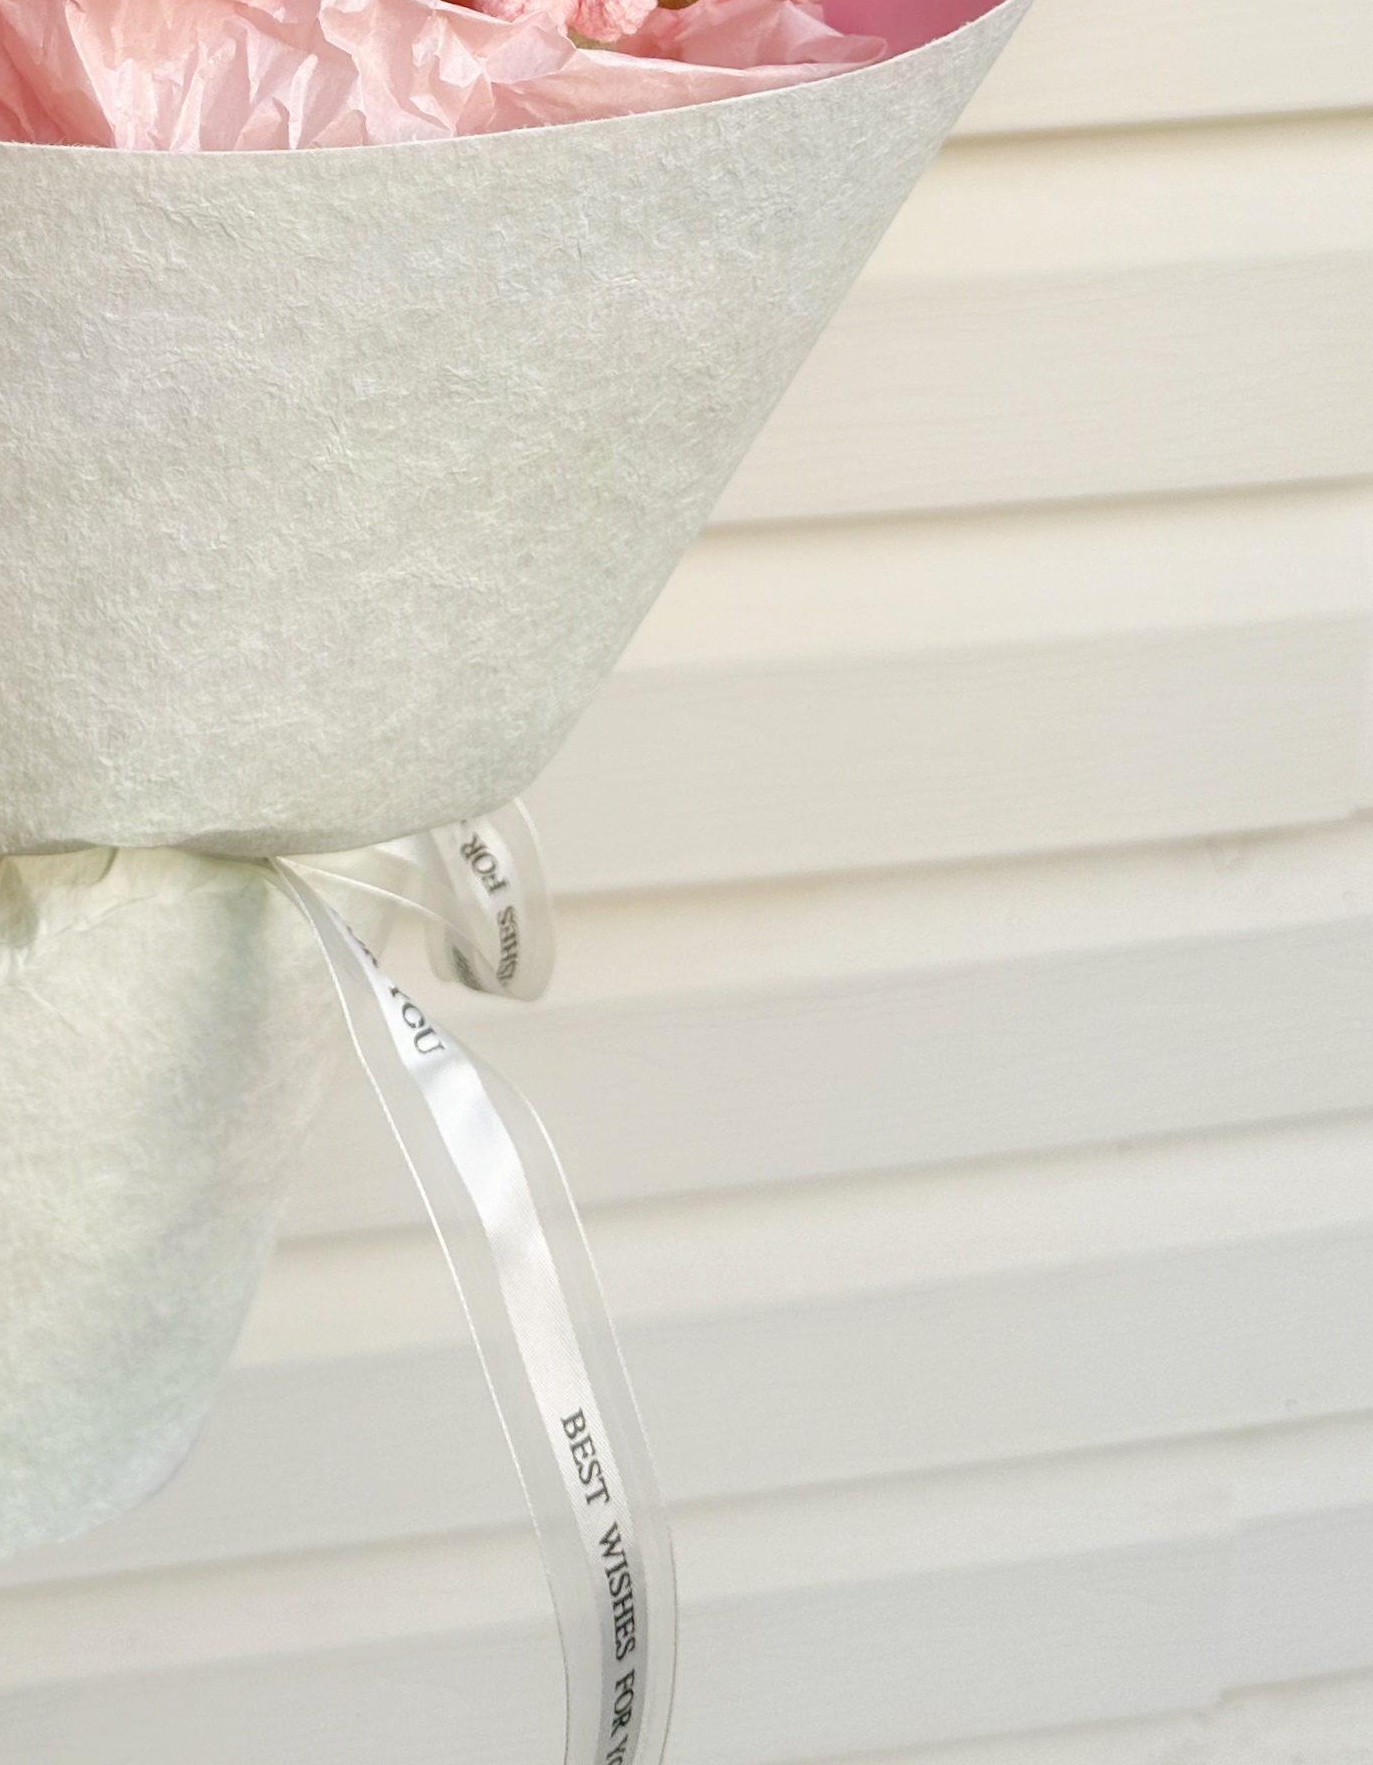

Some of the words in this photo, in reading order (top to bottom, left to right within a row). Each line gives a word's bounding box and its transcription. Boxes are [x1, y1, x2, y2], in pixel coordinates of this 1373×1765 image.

[459, 831, 509, 897] FOR
[560, 1407, 611, 1507] BEST
[598, 1520, 637, 1662] WISHES
[610, 1667, 636, 1738] FOR
